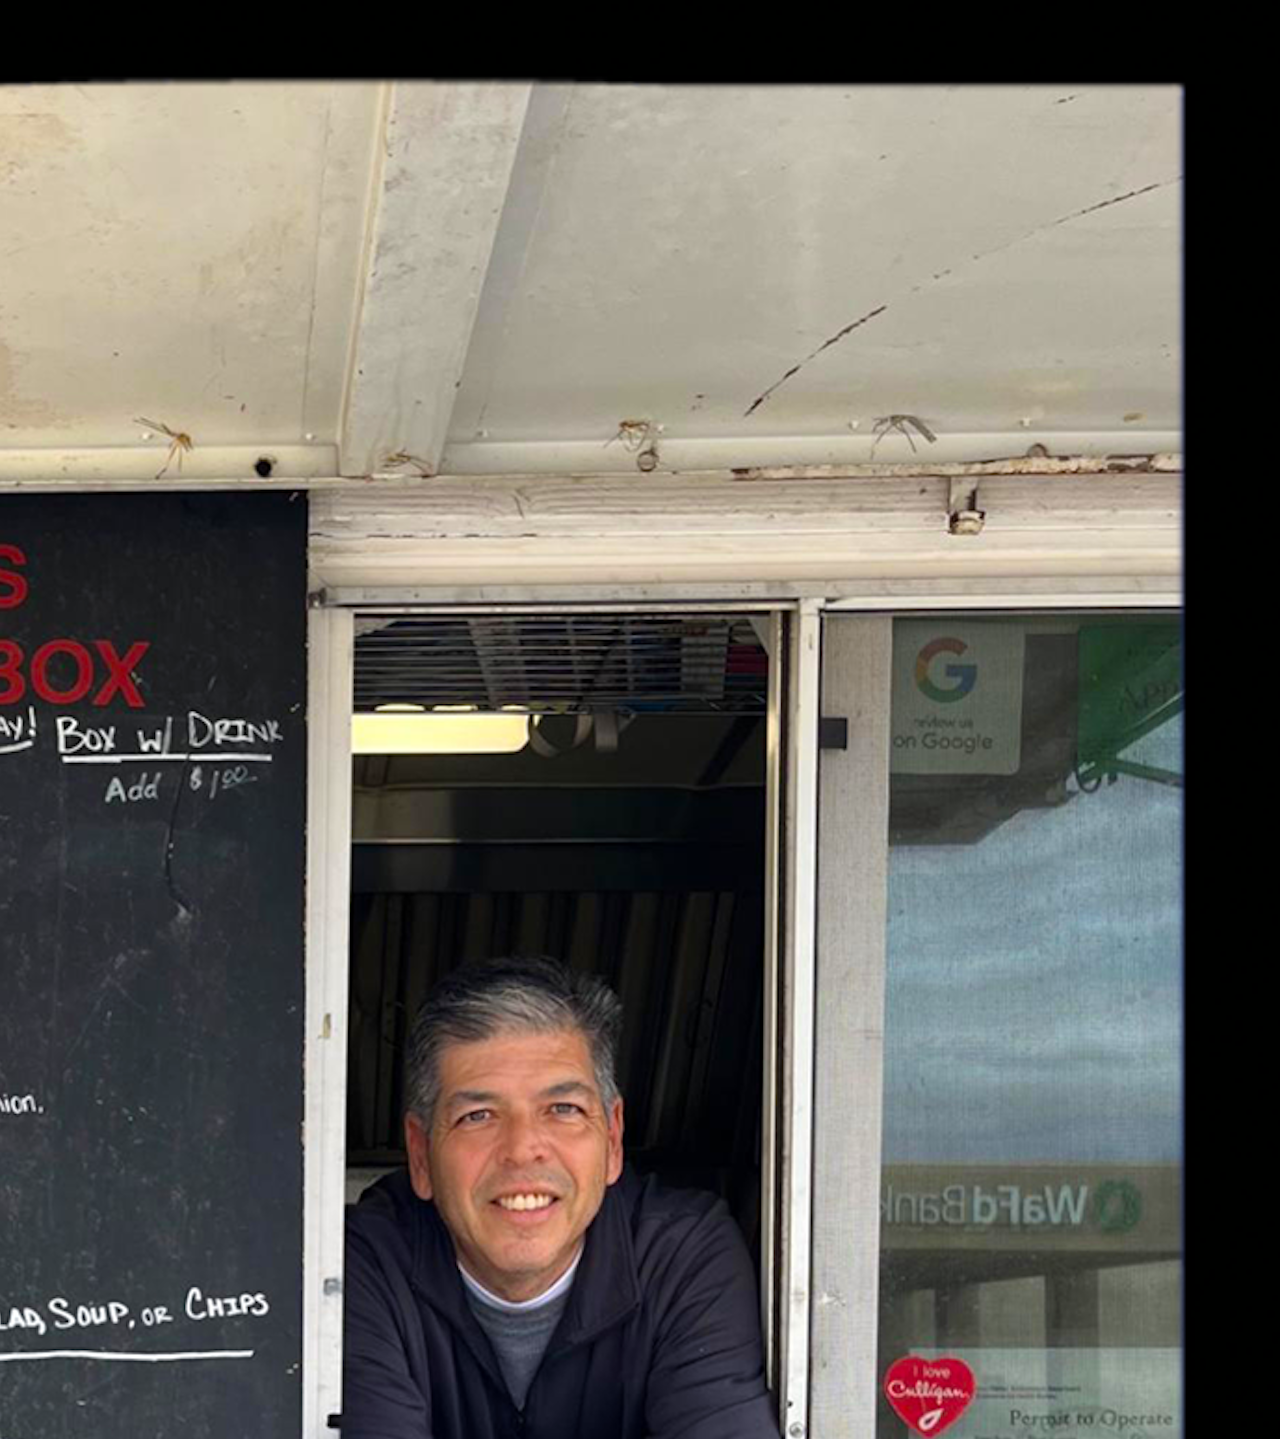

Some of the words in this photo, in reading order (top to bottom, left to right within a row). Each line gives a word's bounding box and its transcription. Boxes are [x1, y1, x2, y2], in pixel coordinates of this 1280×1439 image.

[56, 716, 116, 754] BOX
[188, 711, 283, 748] DRINK
[893, 735, 916, 748] on
[922, 732, 993, 753] Google
[105, 773, 162, 804] Add
[49, 1298, 137, 1330] SOUP,
[142, 1306, 173, 1326] OR
[185, 1287, 270, 1320] CHIPS
[922, 1367, 950, 1378] love
[1010, 1410, 1069, 1427] Permit
[1077, 1410, 1093, 1426] to
[1100, 1410, 1173, 1430] Operate
